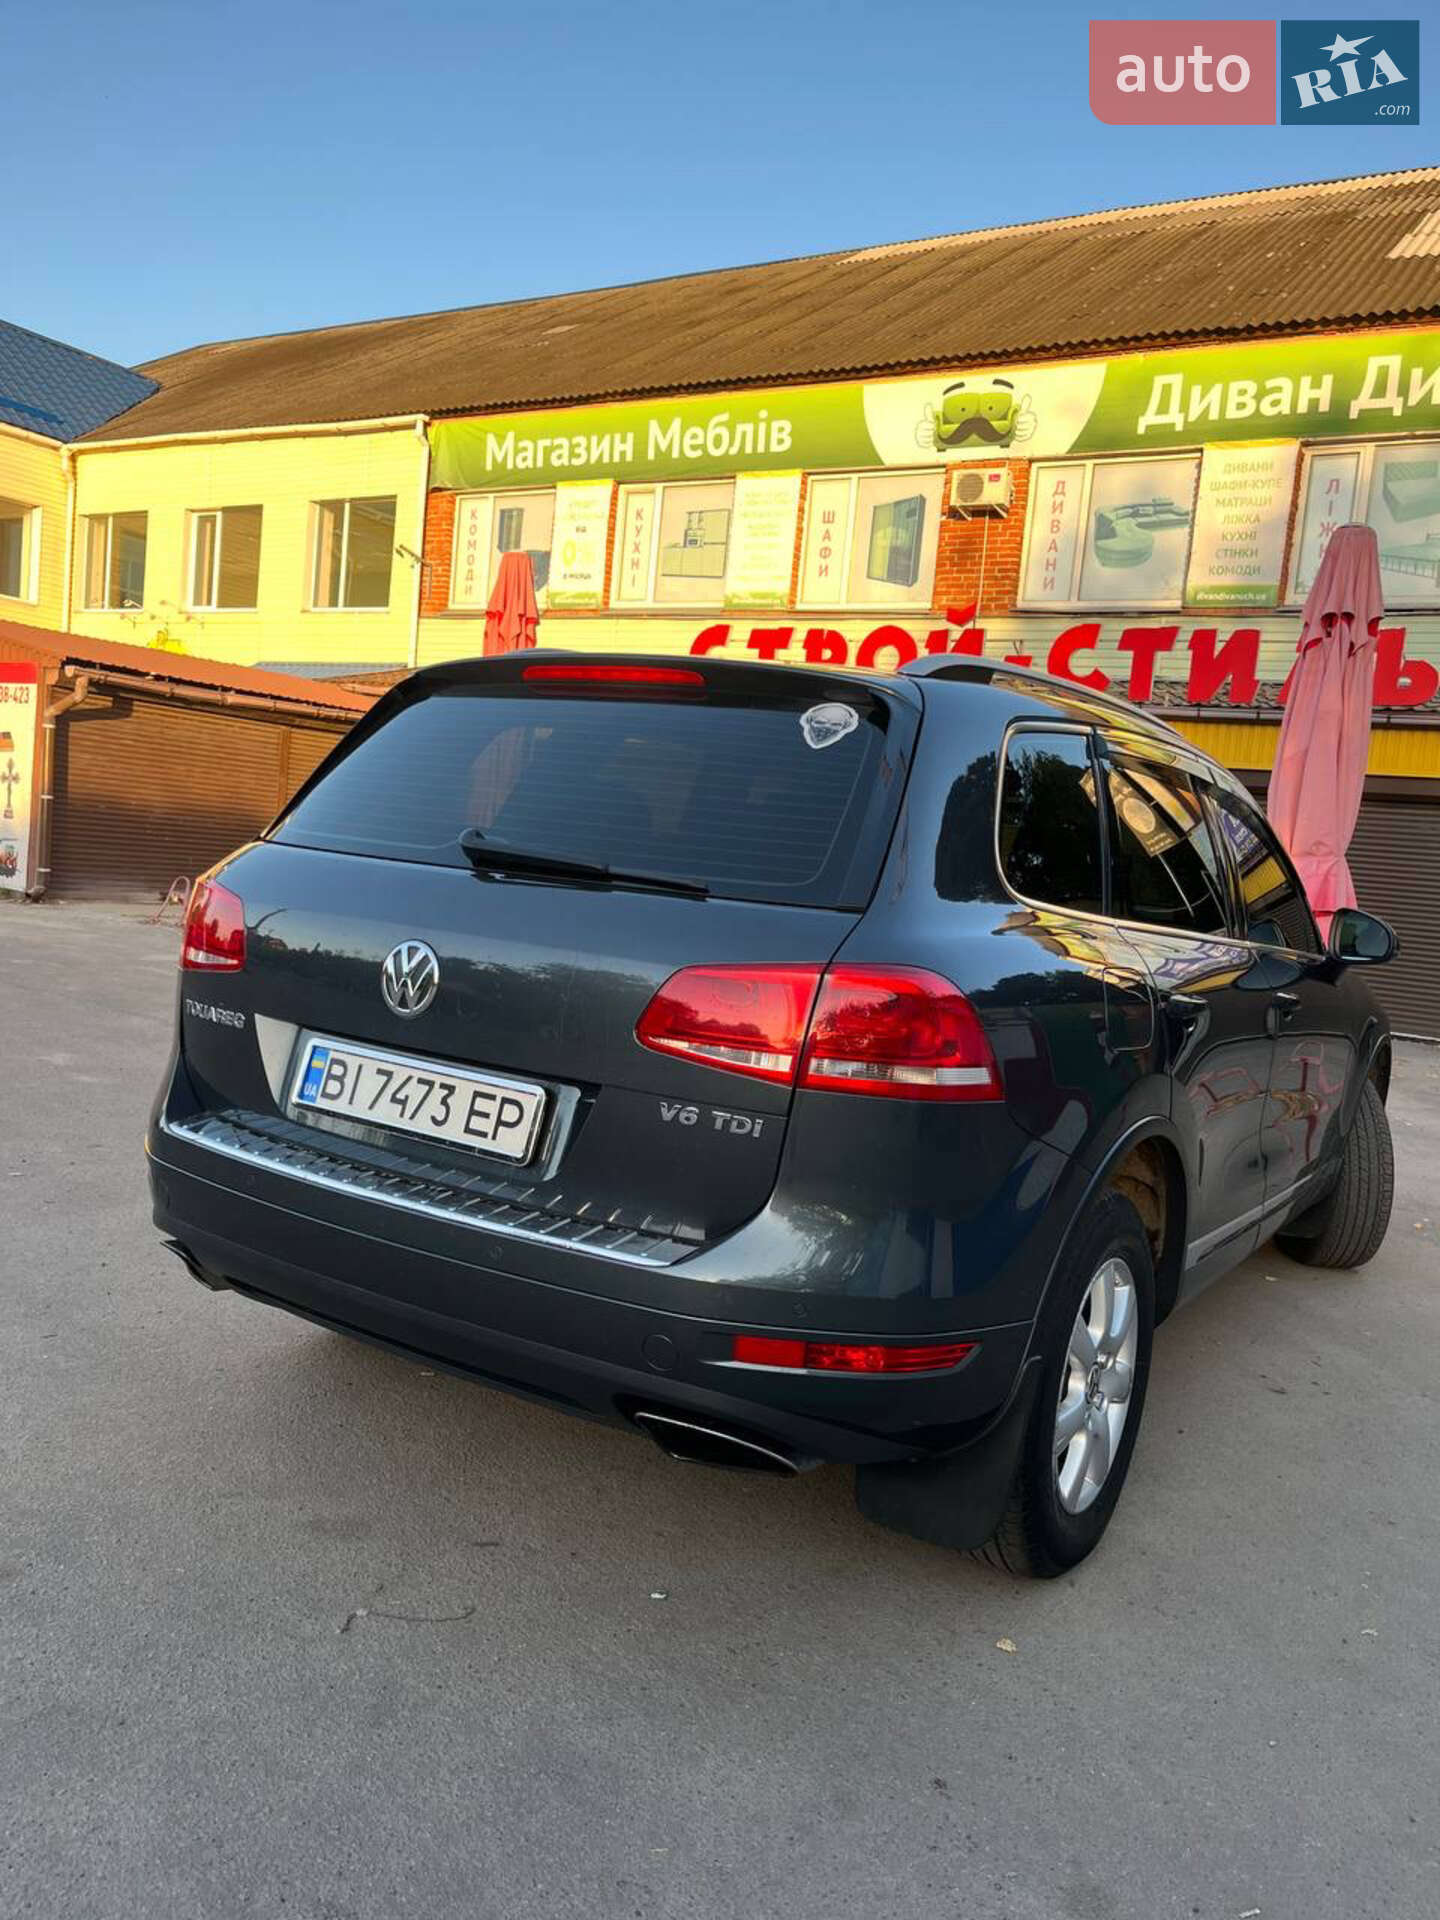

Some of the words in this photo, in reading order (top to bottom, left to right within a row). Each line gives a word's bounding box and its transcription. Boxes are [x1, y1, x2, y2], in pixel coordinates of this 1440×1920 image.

[1136, 373, 1334, 434] Диван
[485, 431, 634, 472] Магазин
[647, 410, 793, 460] Меблів
[465, 507, 478, 597] КОМОДИ
[629, 506, 645, 588] КУХНІ
[818, 509, 836, 578] ШАФИ
[1042, 480, 1067, 591] ДИВАНИ
[1318, 478, 1341, 558] ЛІЖ
[1208, 565, 1262, 577] КОМОДИ
[303, 1082, 319, 1097] UA
[320, 1057, 363, 1105] BI
[368, 1067, 457, 1127] 7473
[464, 1090, 524, 1140] EP
[660, 1101, 699, 1126] V6
